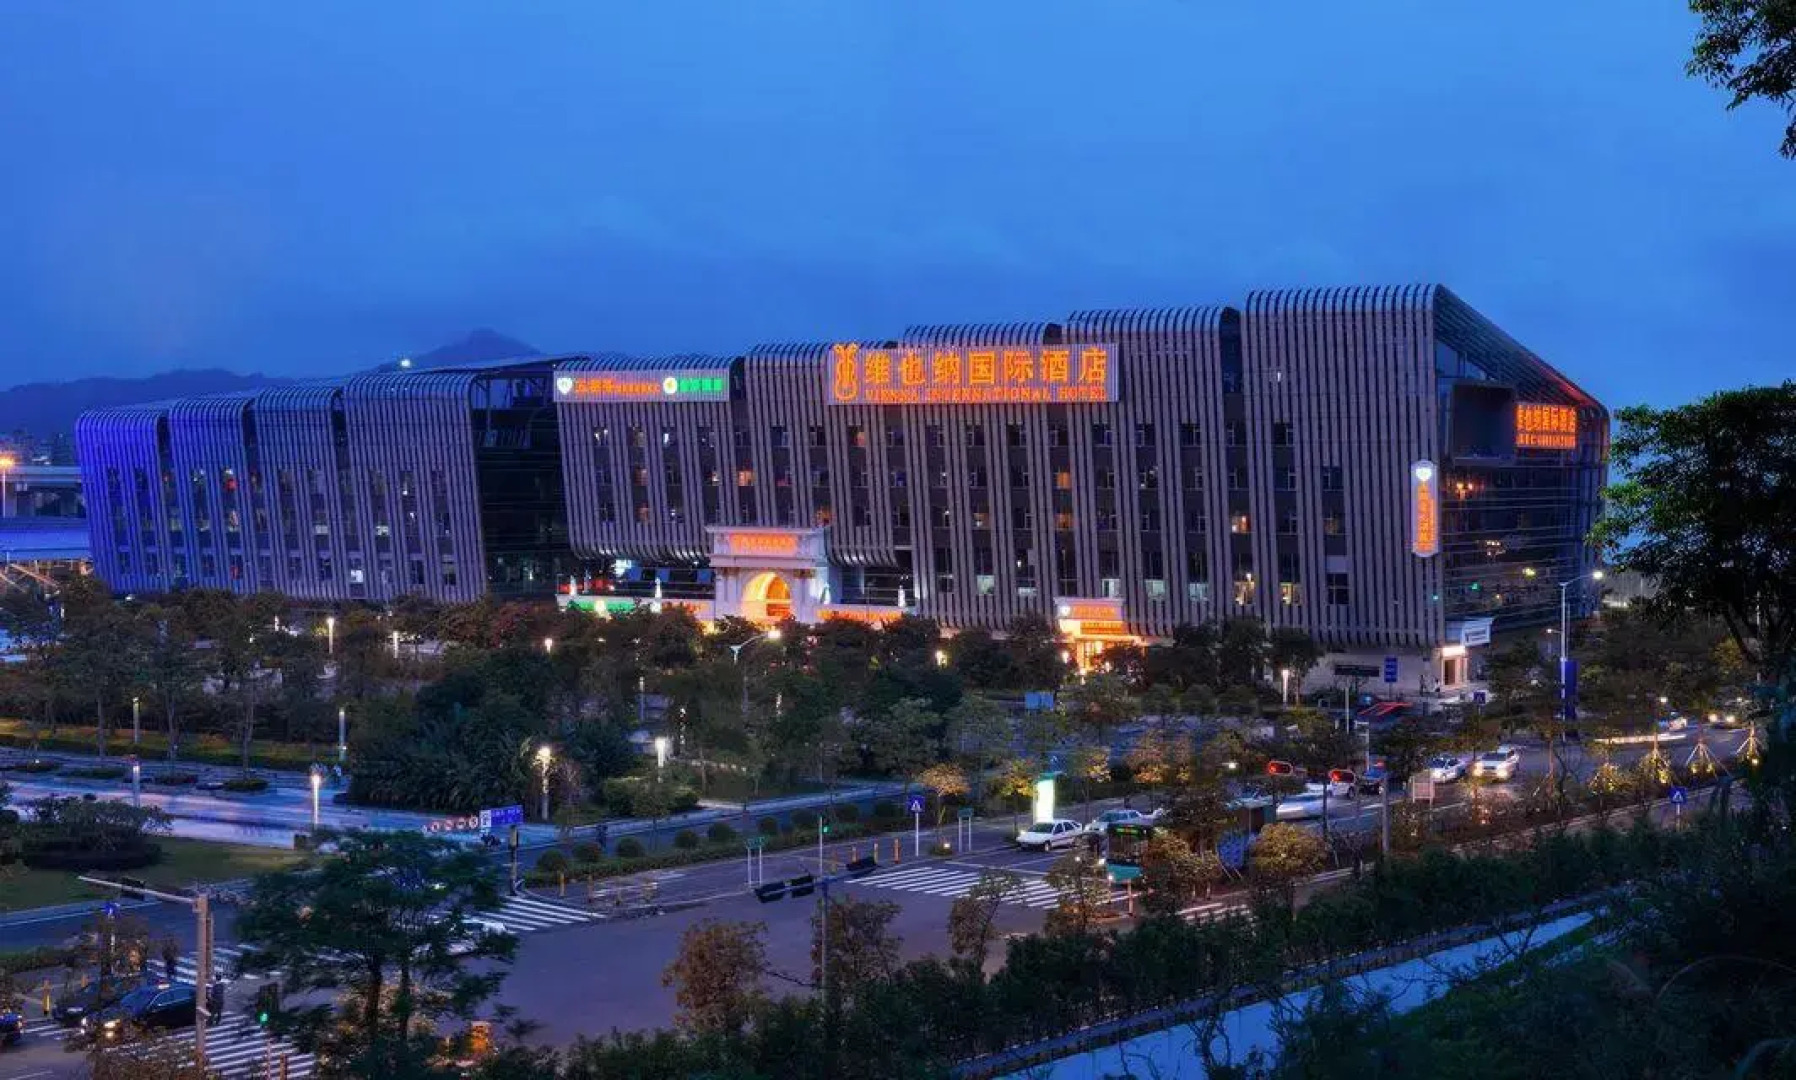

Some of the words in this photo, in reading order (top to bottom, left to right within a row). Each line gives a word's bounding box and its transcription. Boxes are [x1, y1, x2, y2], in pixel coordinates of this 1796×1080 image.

[865, 347, 1108, 384] 维也纳国际酒店
[925, 387, 1051, 402] INTERNATIONAL
[1059, 386, 1107, 401] HOTEL
